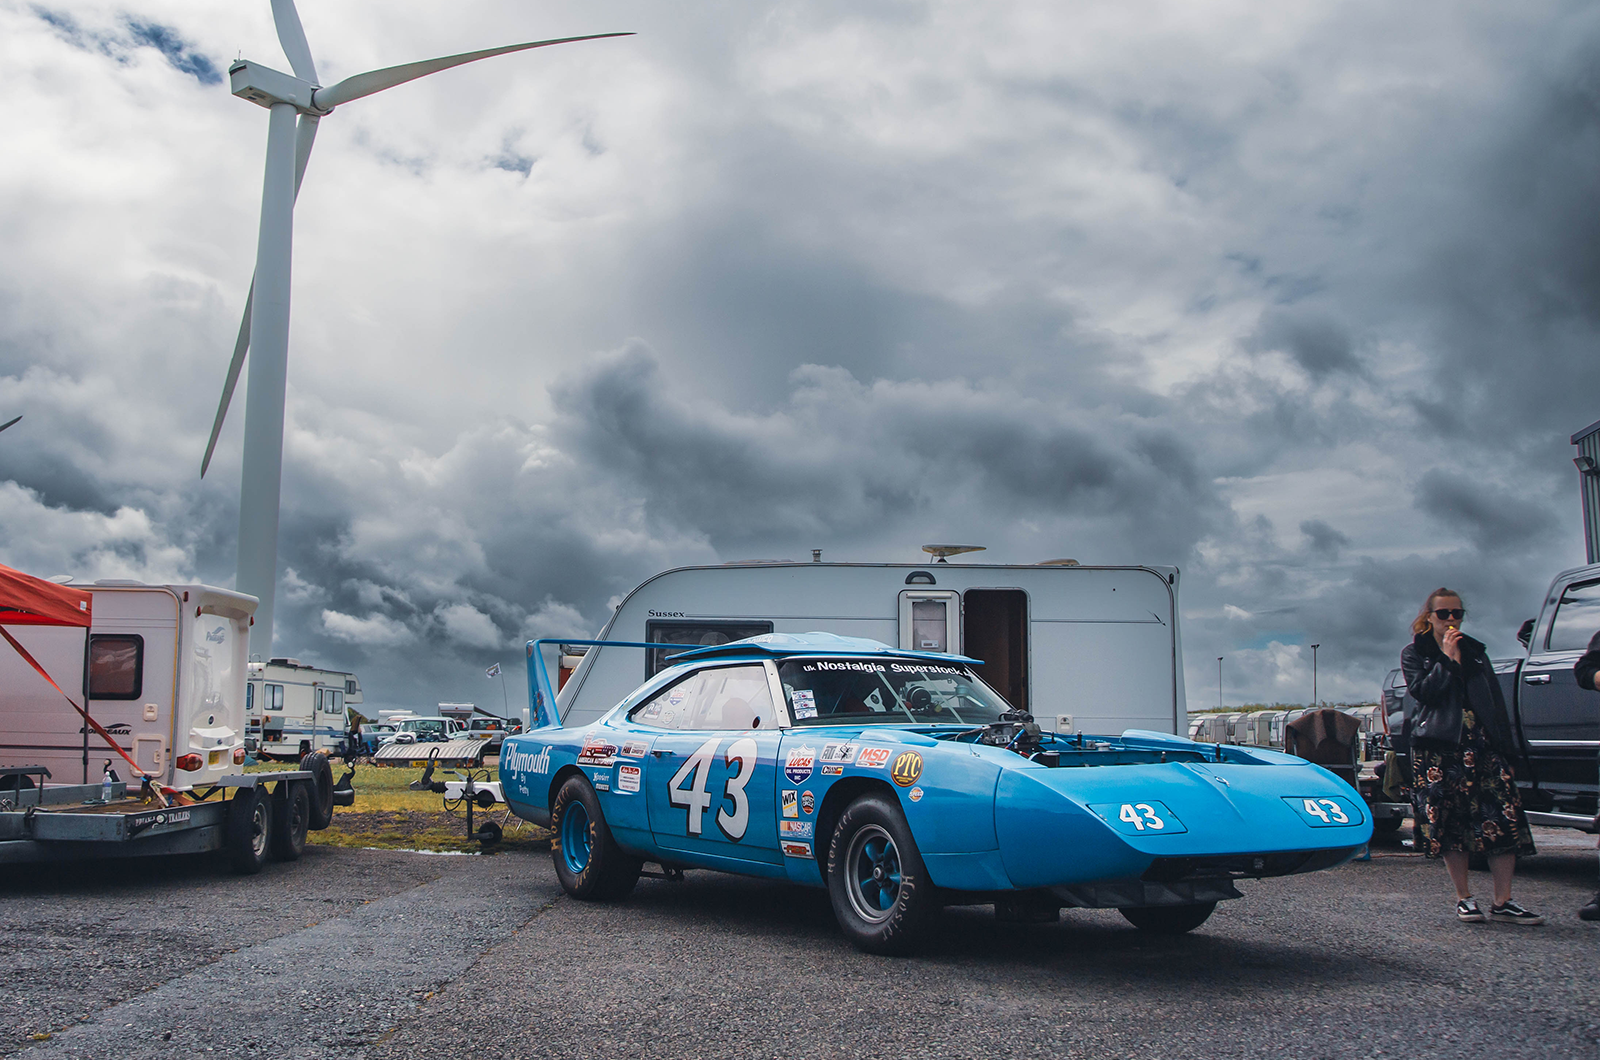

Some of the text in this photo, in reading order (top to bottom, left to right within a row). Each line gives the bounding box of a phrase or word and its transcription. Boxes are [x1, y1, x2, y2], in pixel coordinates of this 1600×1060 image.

[648, 609, 685, 618] Sussex
[816, 661, 886, 674] Nostalgia
[504, 742, 553, 780] Plymouth
[788, 757, 813, 767] LUCAS
[859, 748, 890, 762] MSD
[893, 753, 922, 778] PTC
[667, 737, 758, 844] 43
[782, 791, 796, 806] WIX
[1119, 803, 1165, 831] 43
[1302, 799, 1350, 824] 43
